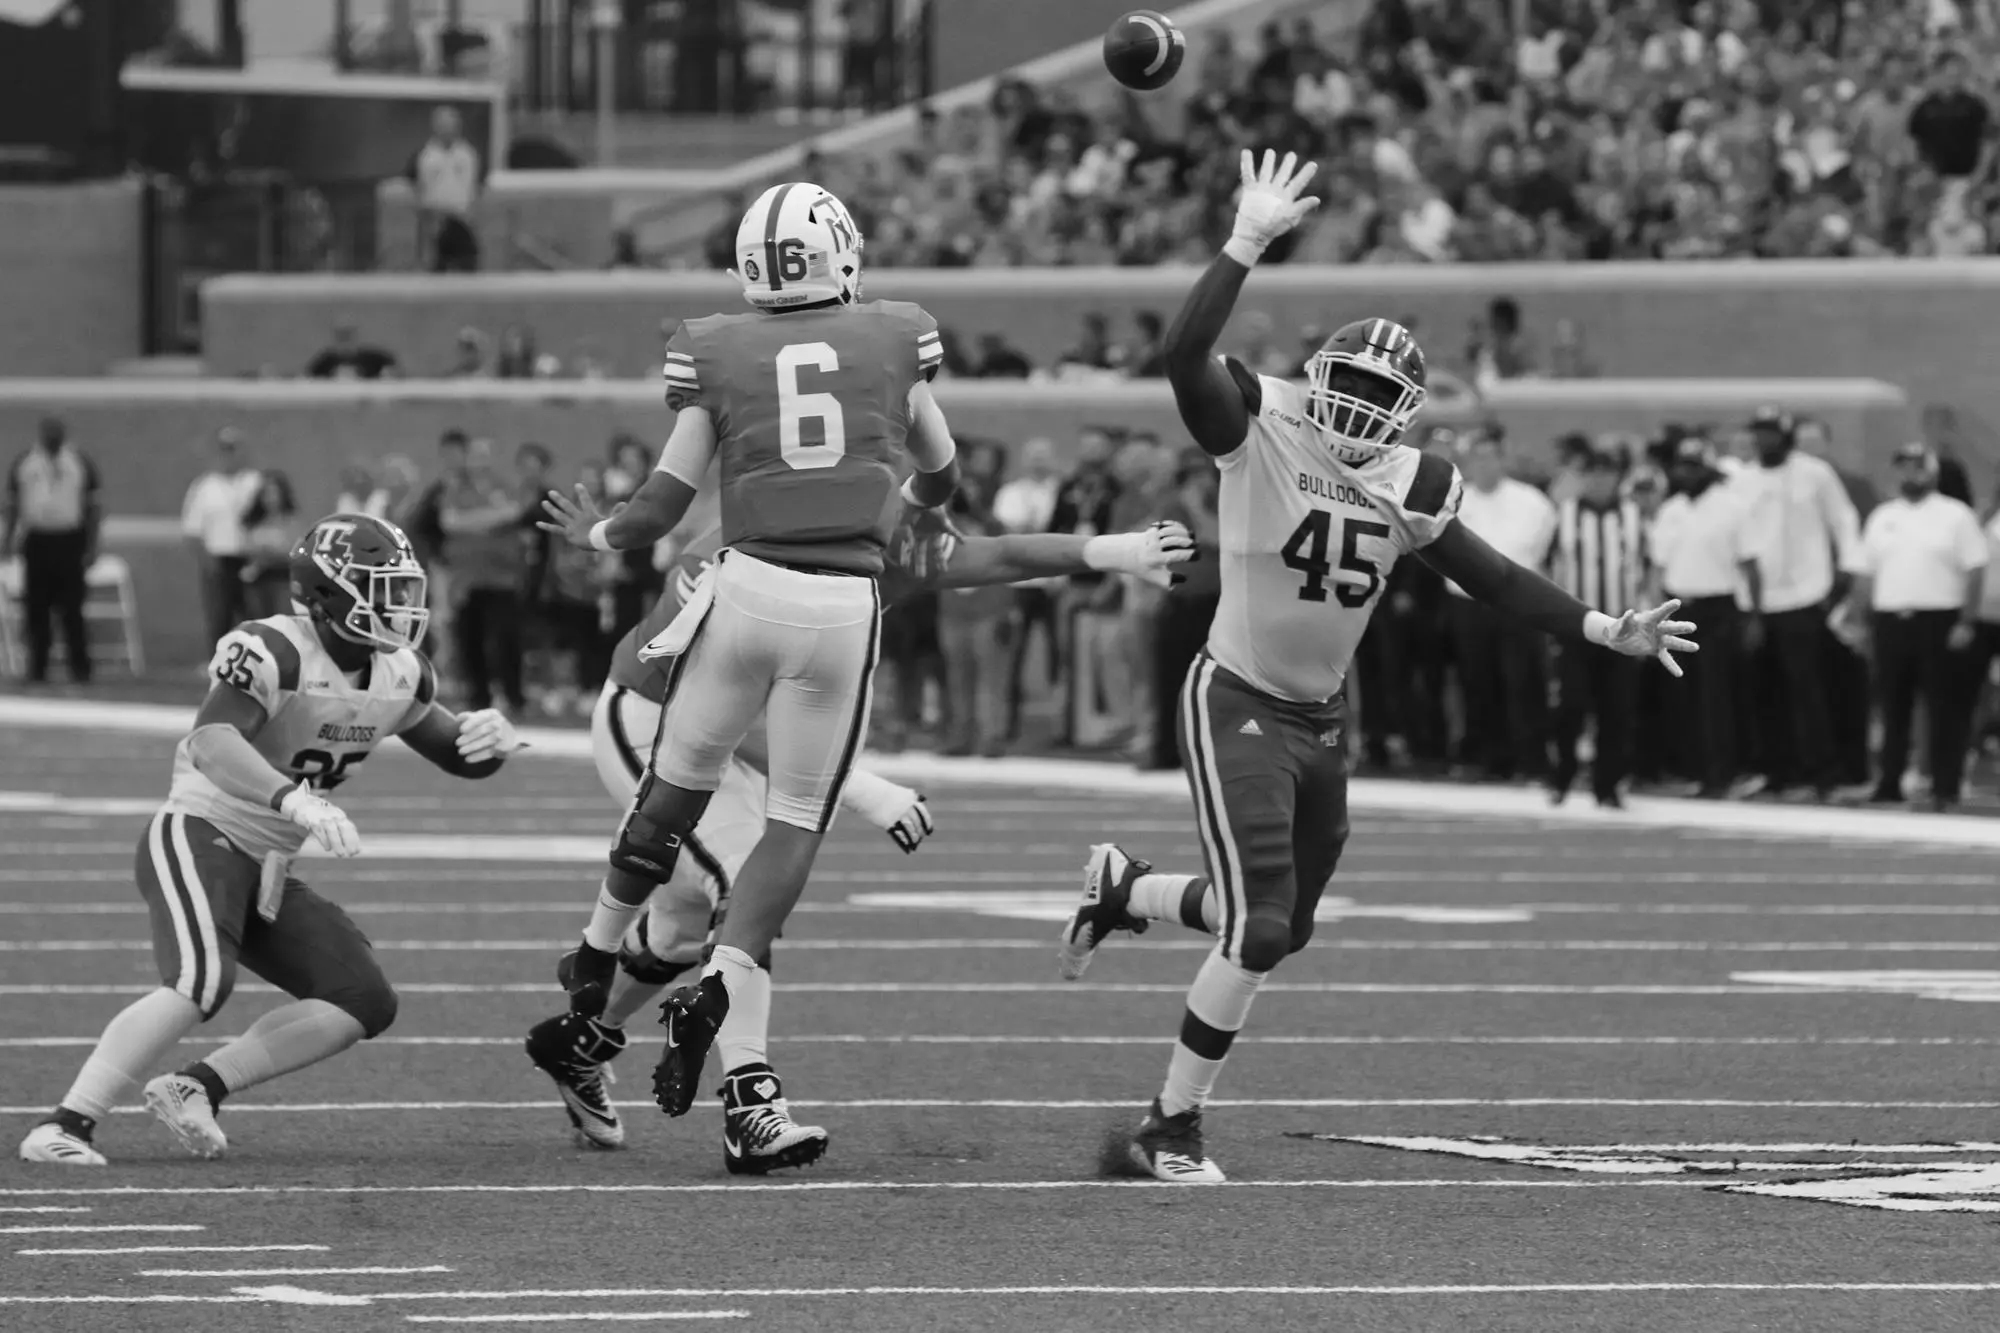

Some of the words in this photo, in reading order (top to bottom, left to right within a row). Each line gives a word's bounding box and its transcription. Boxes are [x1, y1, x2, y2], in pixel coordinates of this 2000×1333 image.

[778, 238, 807, 281] 6
[776, 341, 846, 470] 6
[1280, 508, 1390, 608] 45
[216, 641, 264, 691] 35
[317, 723, 376, 742] BULLDOGS
